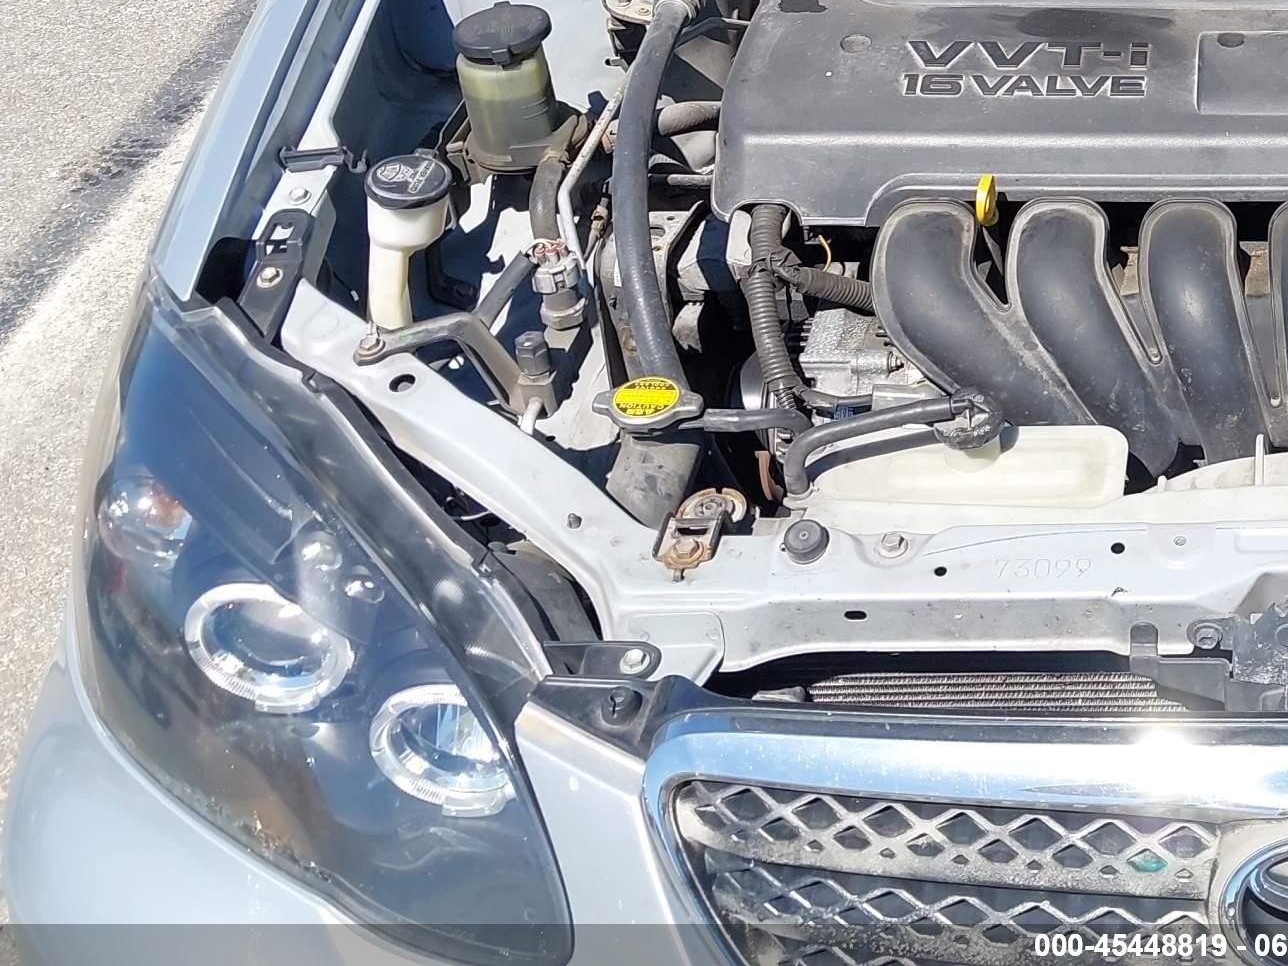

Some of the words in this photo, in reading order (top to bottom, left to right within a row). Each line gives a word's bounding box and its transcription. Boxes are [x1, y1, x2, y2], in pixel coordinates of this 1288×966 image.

[907, 40, 1150, 70] VVT-i
[903, 73, 964, 97] 16
[969, 73, 1148, 97] VALVE
